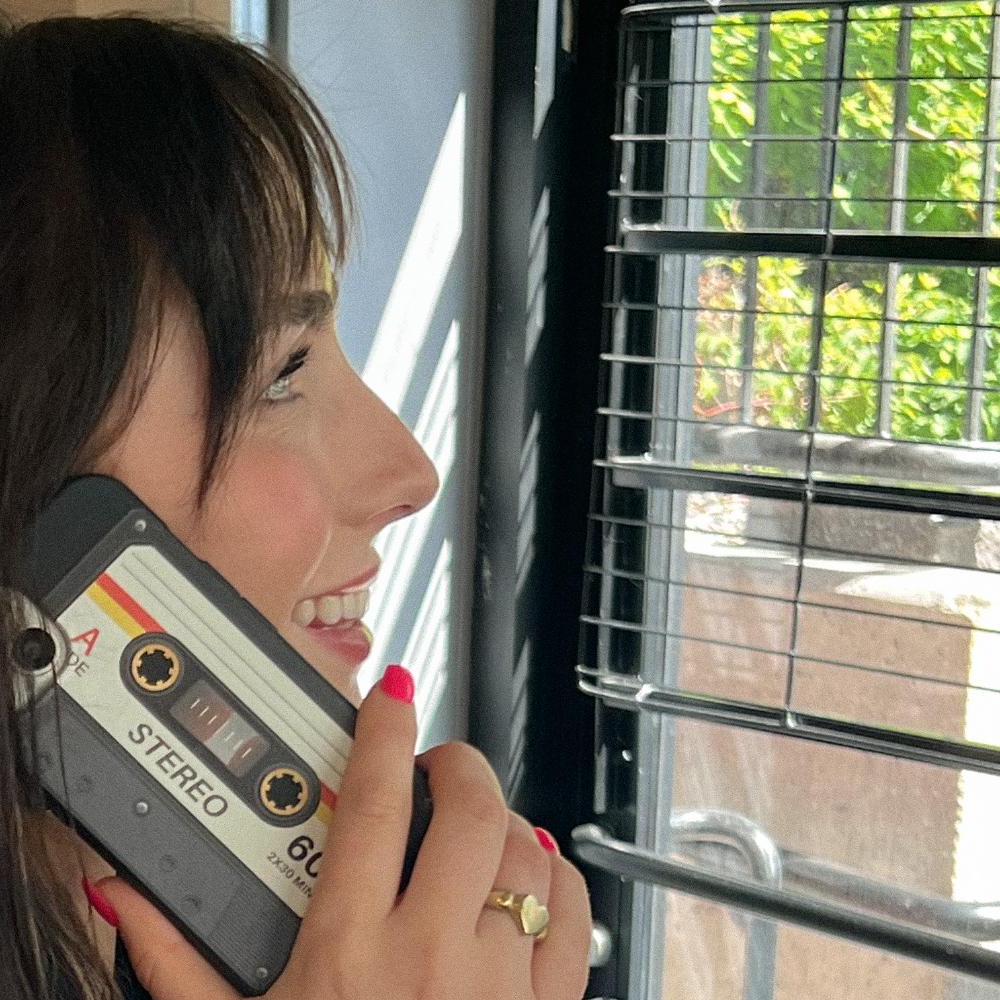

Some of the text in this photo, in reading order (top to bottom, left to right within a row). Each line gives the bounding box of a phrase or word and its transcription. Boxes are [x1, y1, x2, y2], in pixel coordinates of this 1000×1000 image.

[71, 628, 100, 657] A
[70, 652, 90, 677] DE
[128, 722, 229, 818] STEREO
